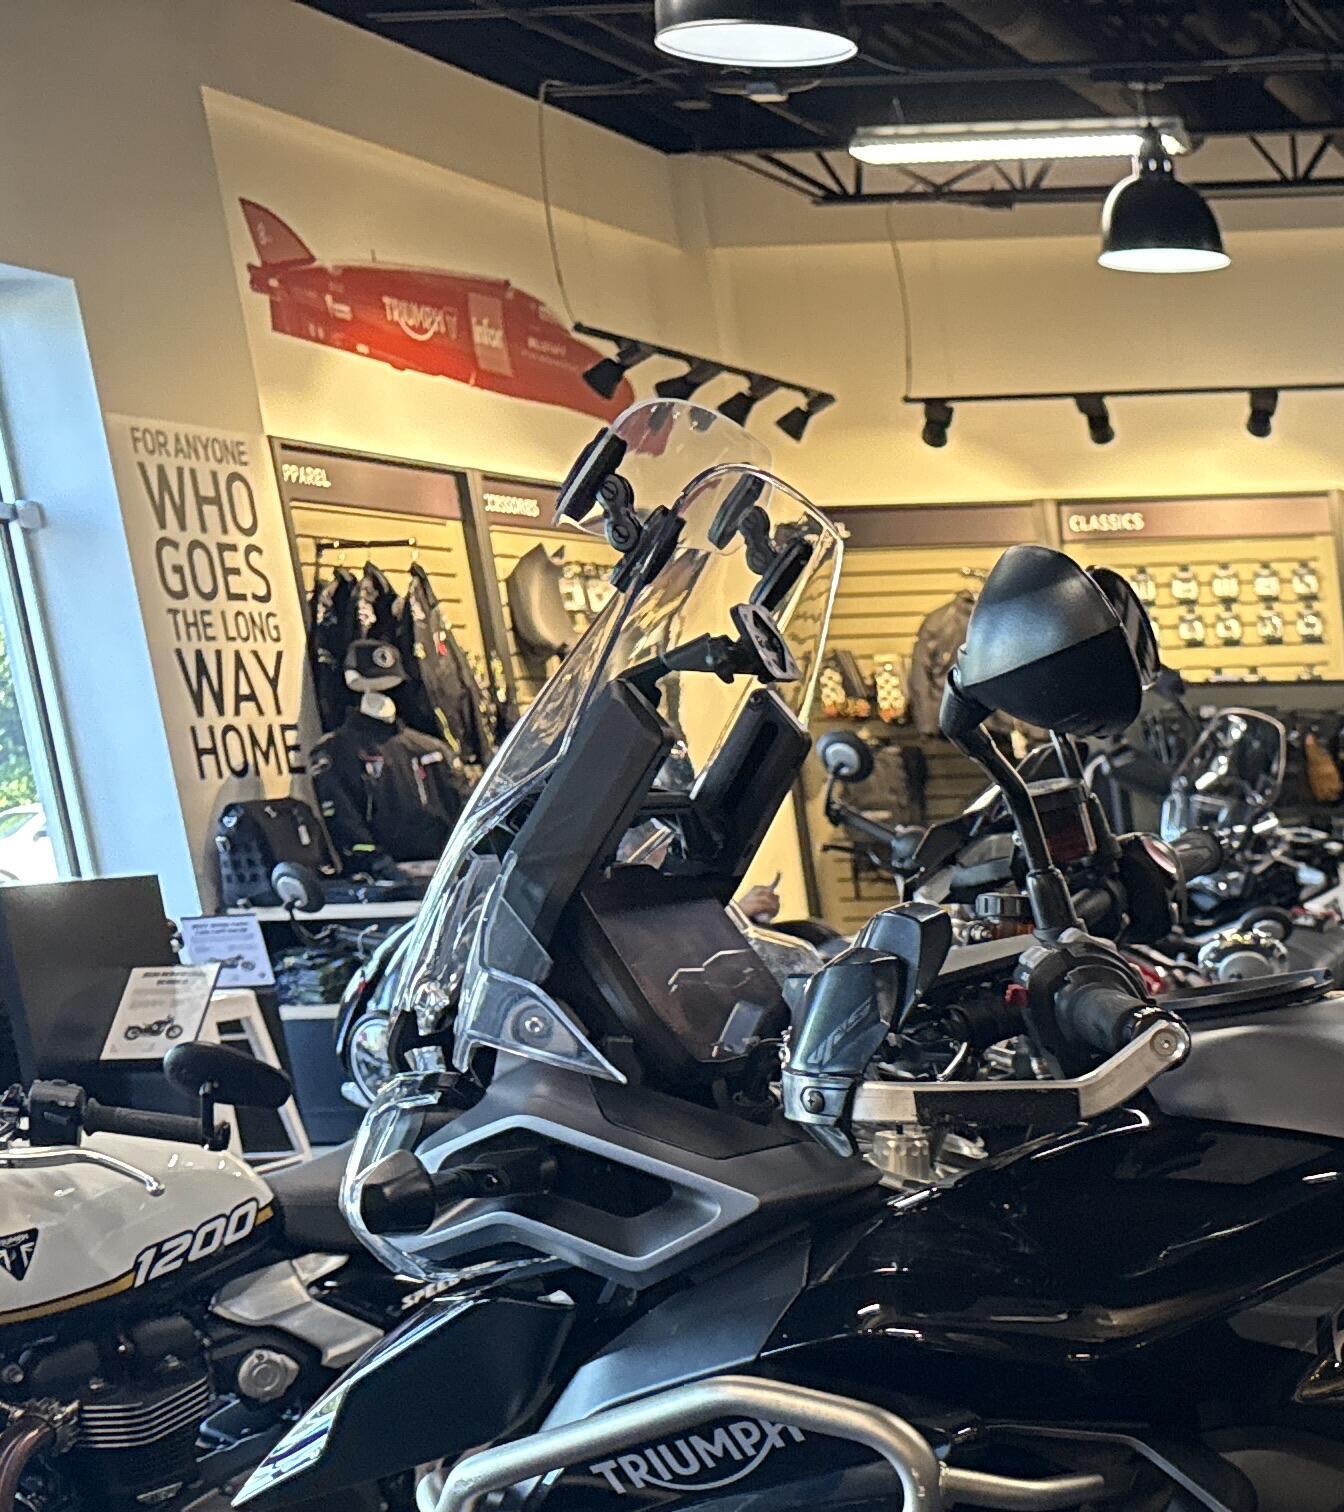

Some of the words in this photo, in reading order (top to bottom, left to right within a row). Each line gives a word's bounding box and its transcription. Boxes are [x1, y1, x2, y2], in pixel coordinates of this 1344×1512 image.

[130, 427, 170, 457] FOR
[174, 434, 249, 467] ANYONE
[137, 462, 259, 537] WHO
[1069, 512, 1145, 532] CLASSICS
[155, 536, 272, 604] GOES
[167, 608, 218, 642] THE
[221, 610, 281, 643] LONG
[175, 648, 284, 718] WAY
[190, 723, 307, 780] HOME
[133, 1199, 259, 1289] 1200
[589, 1417, 806, 1495] TRIUMPH
